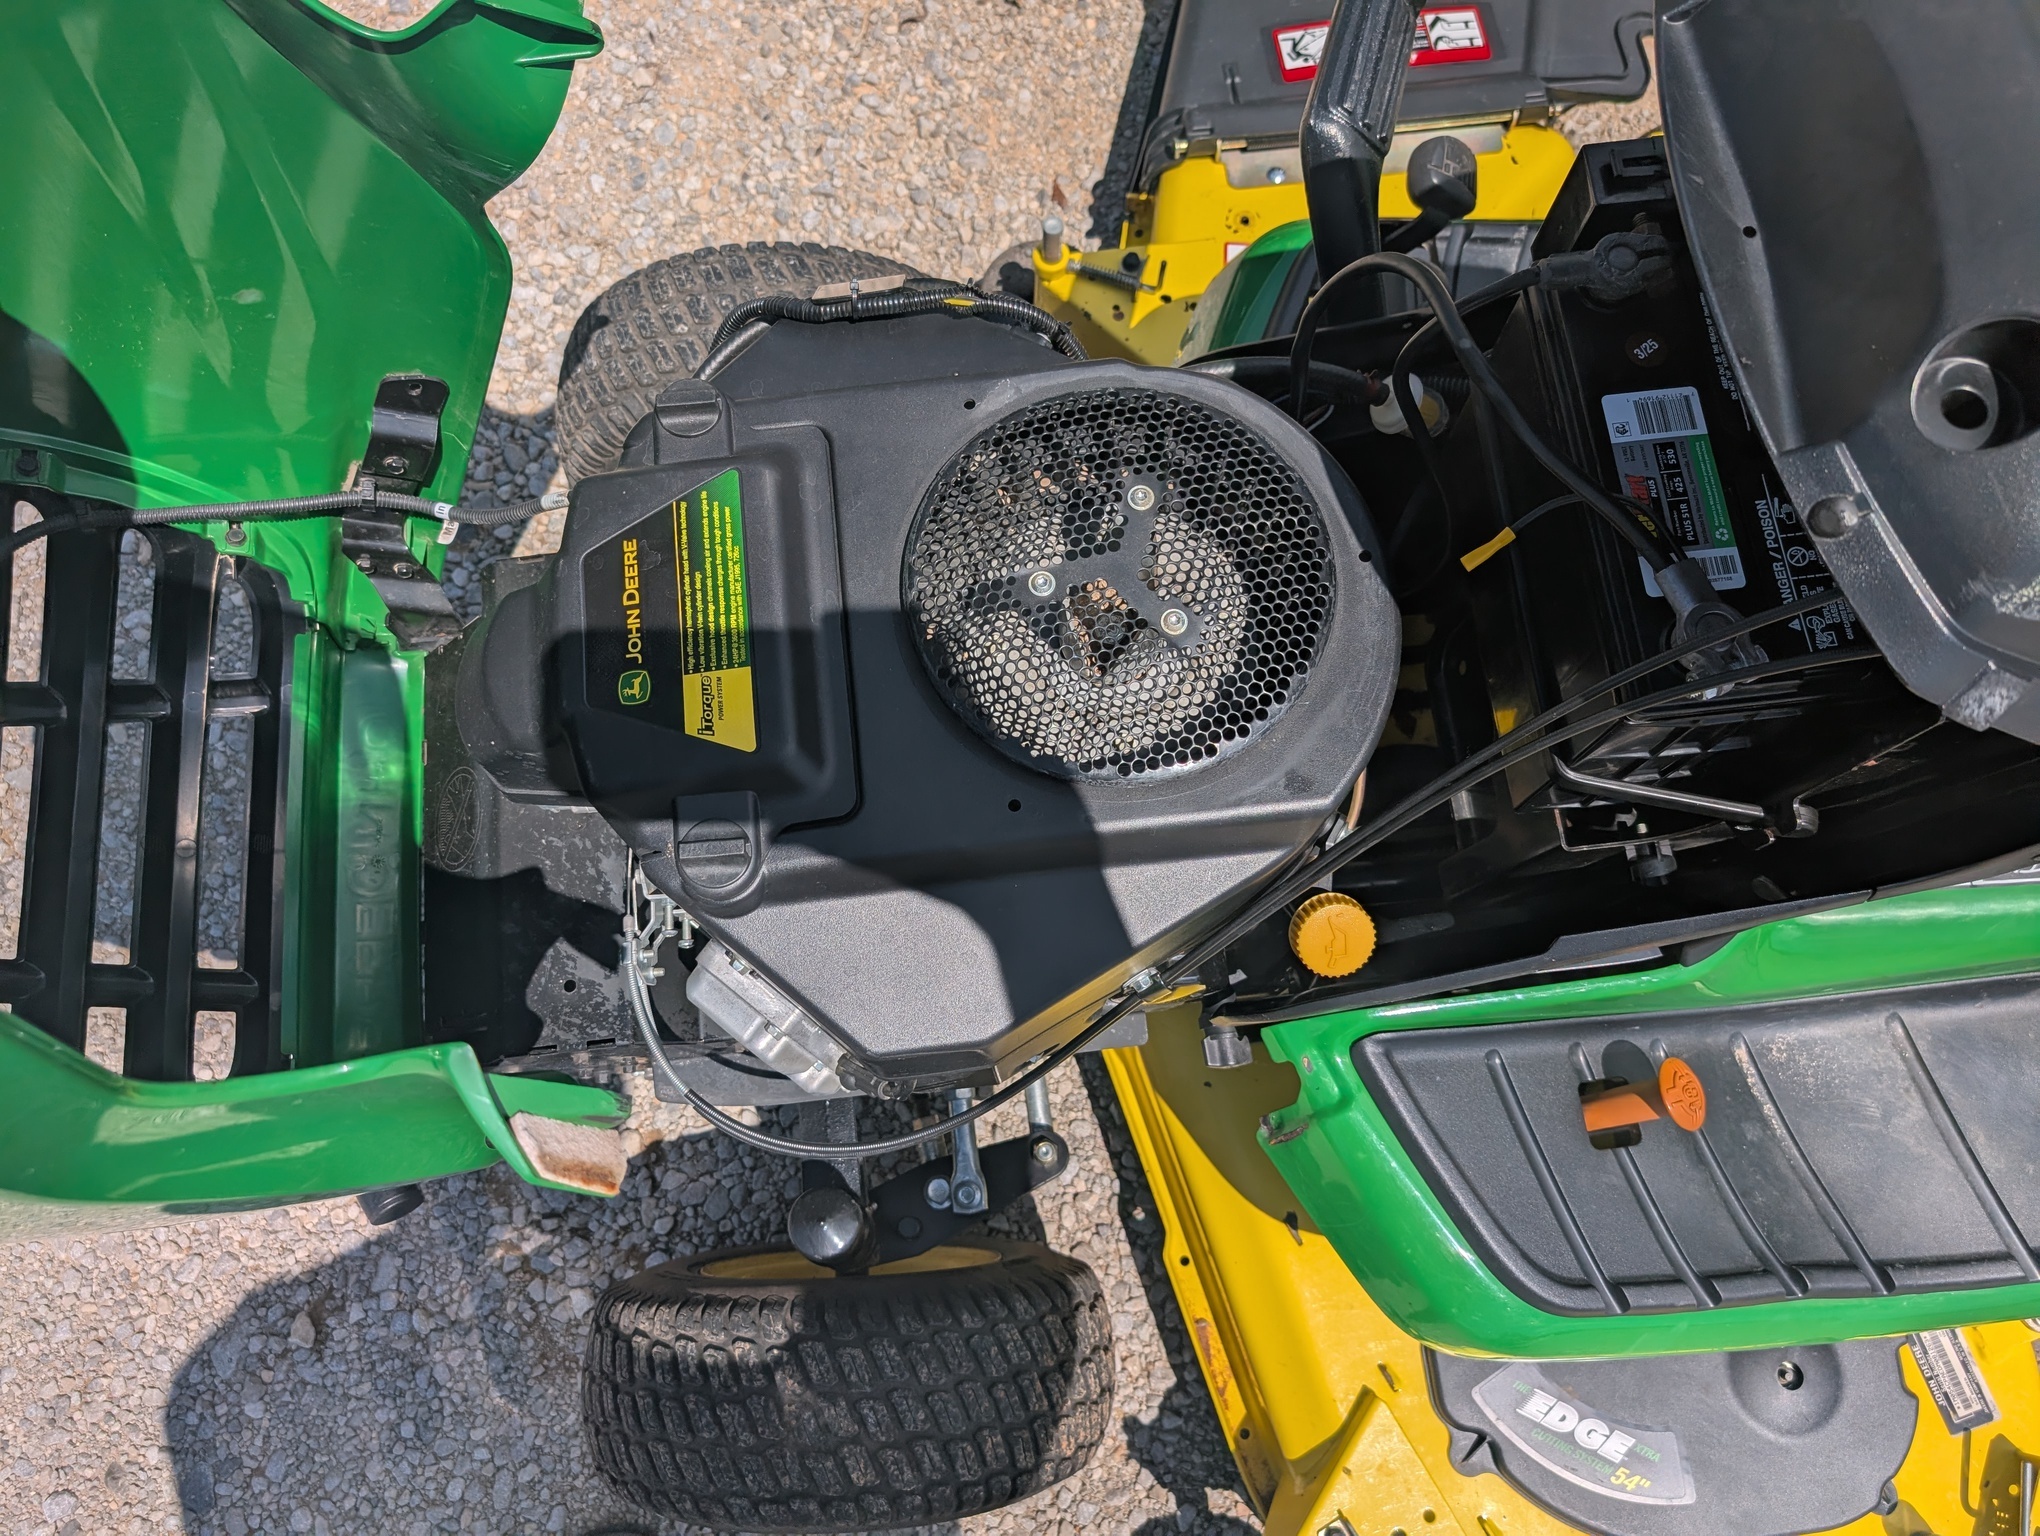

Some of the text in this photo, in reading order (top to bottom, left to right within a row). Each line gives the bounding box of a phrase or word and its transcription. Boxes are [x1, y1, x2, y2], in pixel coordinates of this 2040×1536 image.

[1633, 338, 1659, 360] 3/25
[1665, 447, 1676, 465] 530
[1647, 478, 1658, 498] PLUS
[1672, 476, 1683, 493] 425
[678, 501, 687, 528] technology
[701, 499, 709, 516] engine
[1679, 502, 1695, 541] PLUS 51R
[1754, 497, 1779, 549] POISON
[715, 544, 723, 564] through
[704, 557, 712, 576] cooling
[727, 560, 735, 594] manufacturer
[683, 574, 691, 595] cylinder
[694, 571, 702, 589] design
[705, 577, 713, 601] channels
[1771, 560, 1793, 604] ANGER
[622, 539, 643, 664] JOHN DEERE
[684, 595, 693, 627] hemispheric
[695, 590, 703, 611] cylinder
[707, 602, 715, 622] design
[718, 587, 726, 613] response
[718, 614, 726, 635] throttle
[686, 627, 695, 655] efficiency
[687, 655, 695, 669] High
[731, 647, 739, 663] 24HP
[695, 675, 715, 736] iTorque
[1910, 1343, 1946, 1407] JOHN DEERE
[1924, 1352, 1946, 1392] Serial Number
[1512, 1380, 1532, 1393] THE
[1515, 1388, 1661, 1463] EDGE XTRA
[1531, 1427, 1615, 1475] CUTTING SYSTEM
[1610, 1467, 1652, 1492] 54"
